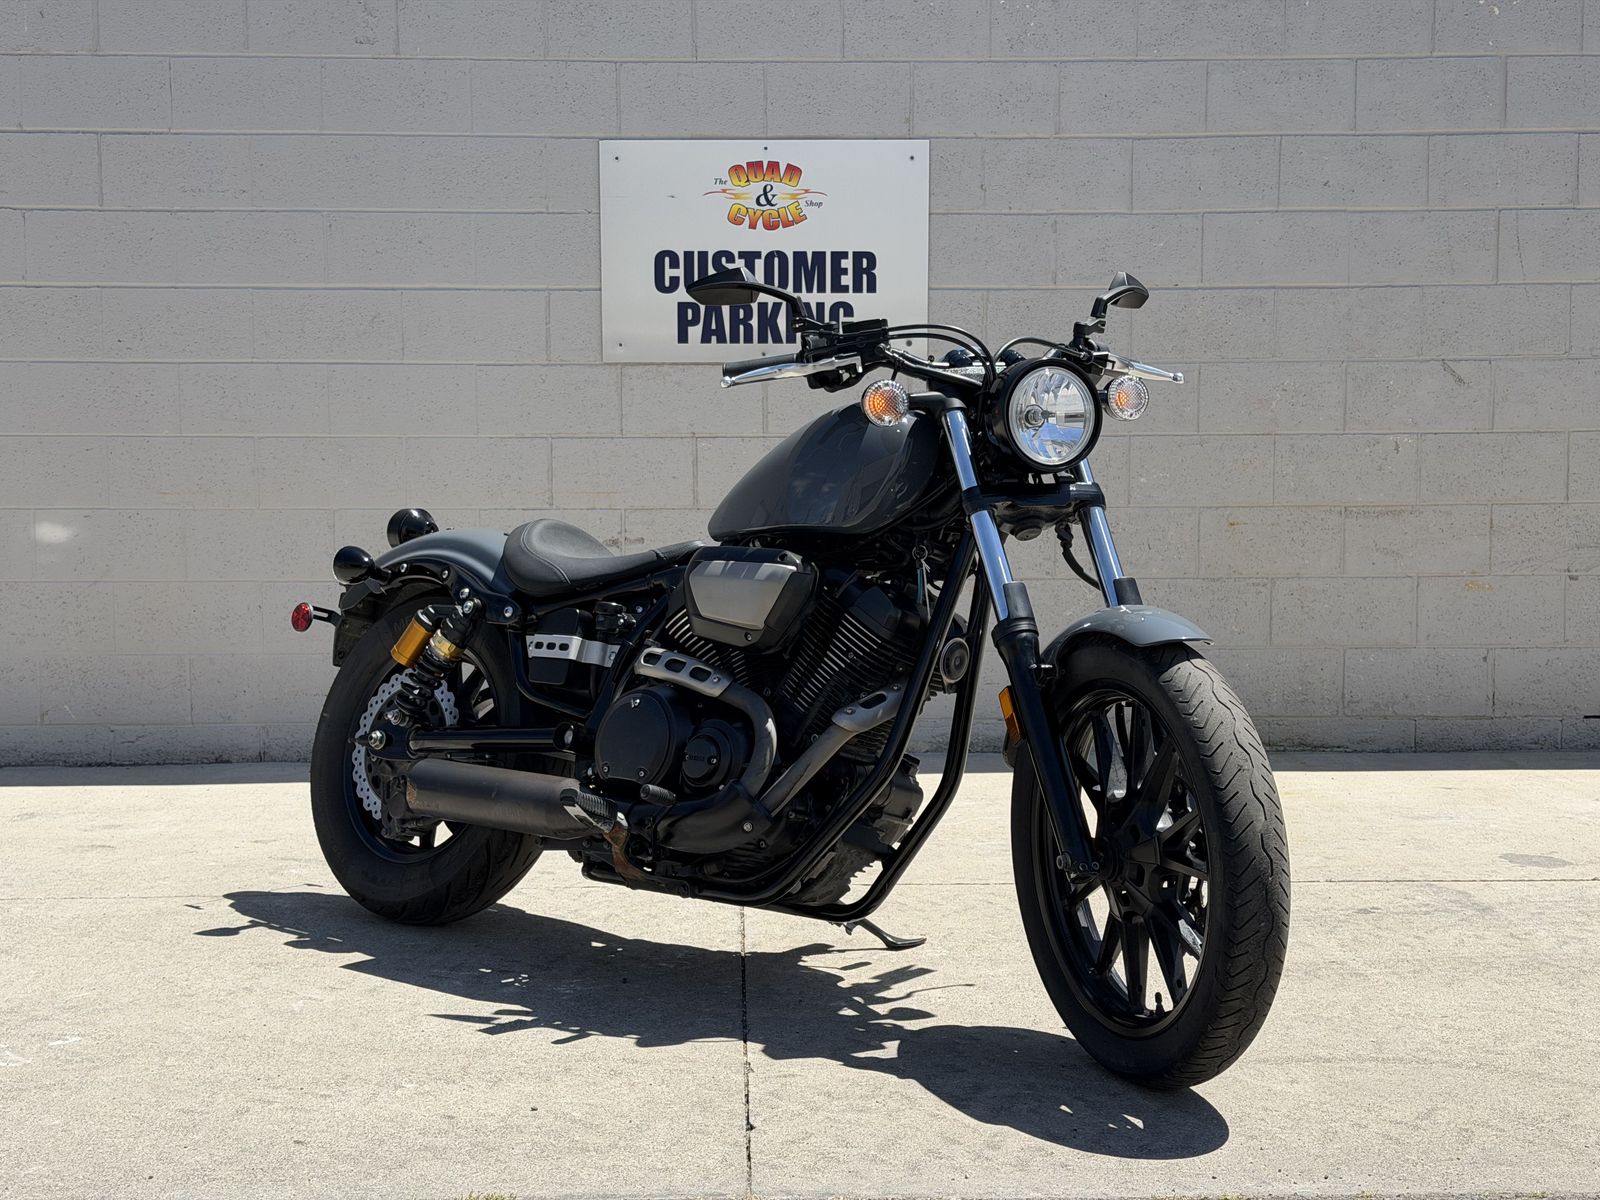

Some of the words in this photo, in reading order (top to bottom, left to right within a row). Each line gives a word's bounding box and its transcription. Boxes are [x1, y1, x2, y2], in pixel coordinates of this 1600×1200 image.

[728, 160, 803, 188] QUAD
[755, 183, 778, 207] &
[727, 201, 808, 231] CYCLE
[804, 200, 823, 208] Shop
[654, 249, 877, 294] CUSTOMER
